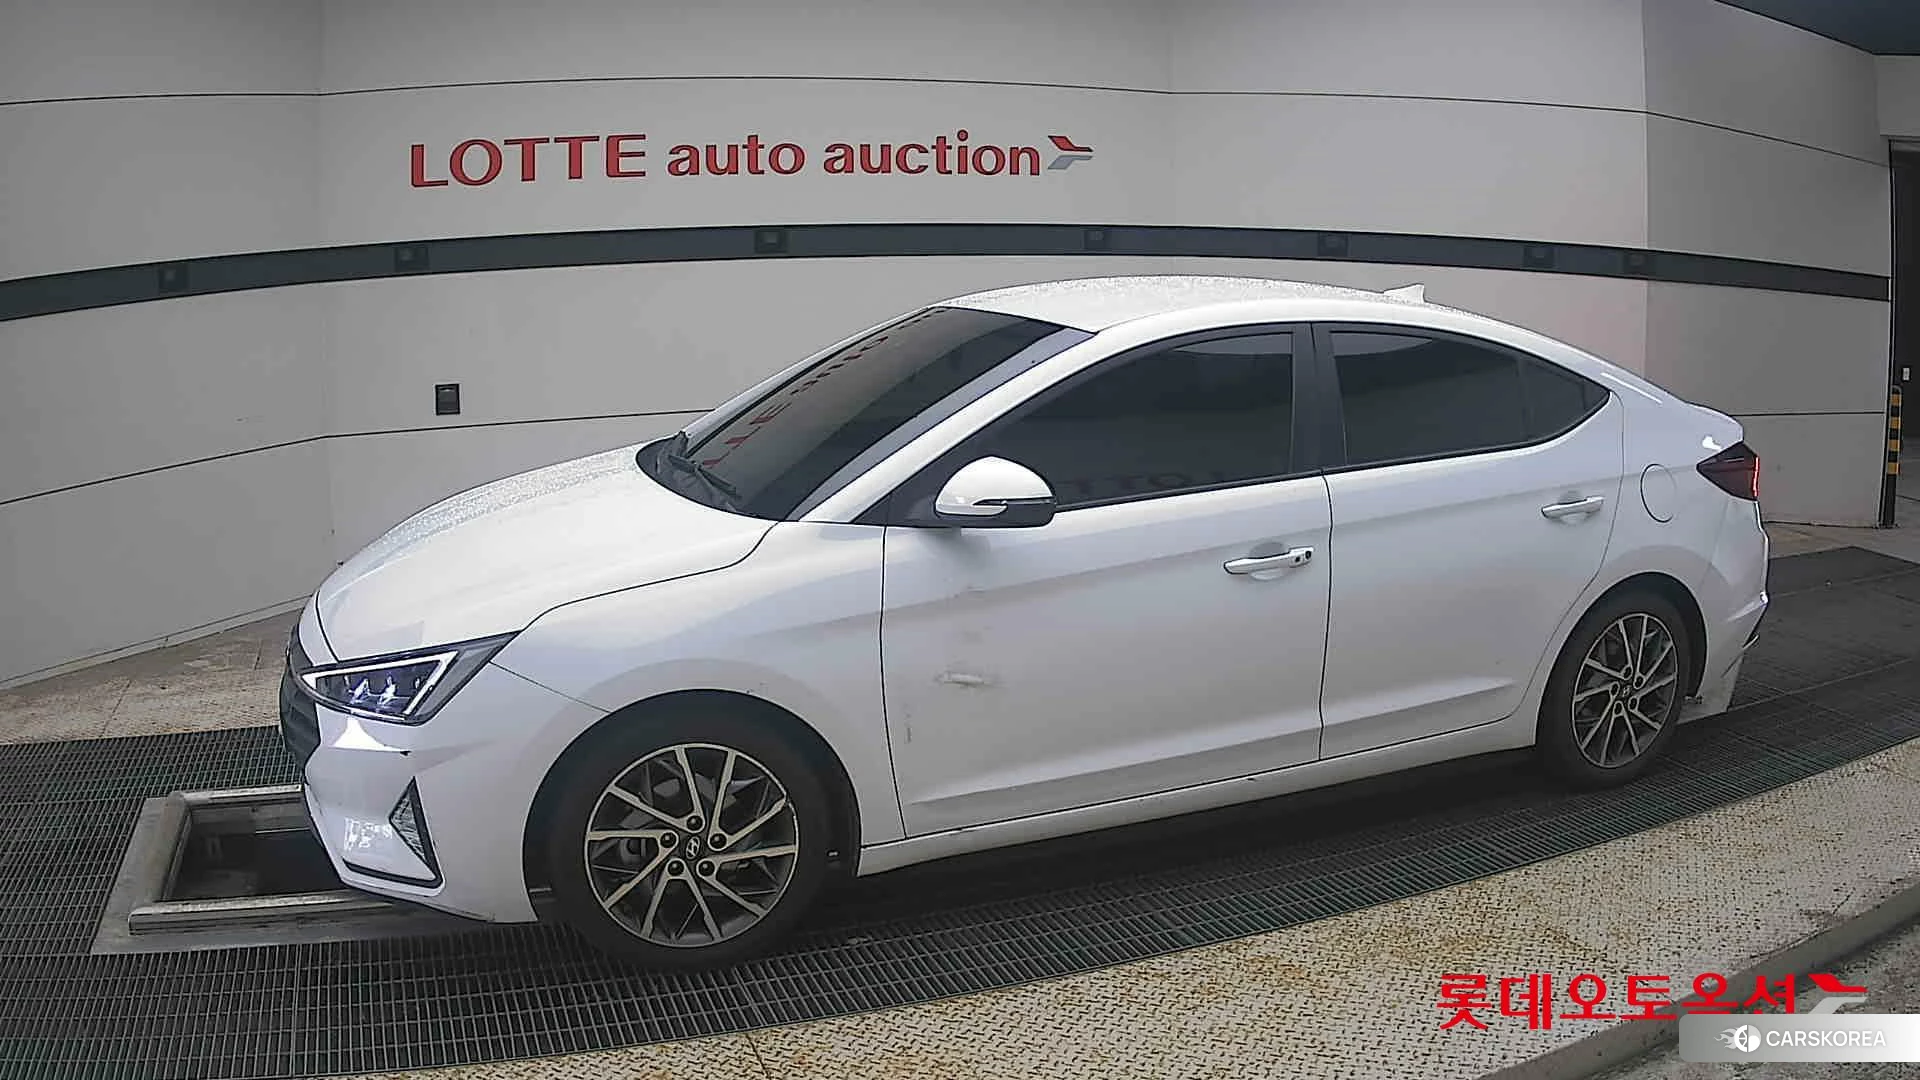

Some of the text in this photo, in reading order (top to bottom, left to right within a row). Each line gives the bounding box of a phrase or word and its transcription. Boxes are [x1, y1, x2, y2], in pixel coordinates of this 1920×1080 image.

[411, 130, 1041, 188] LOTTE auto auction
